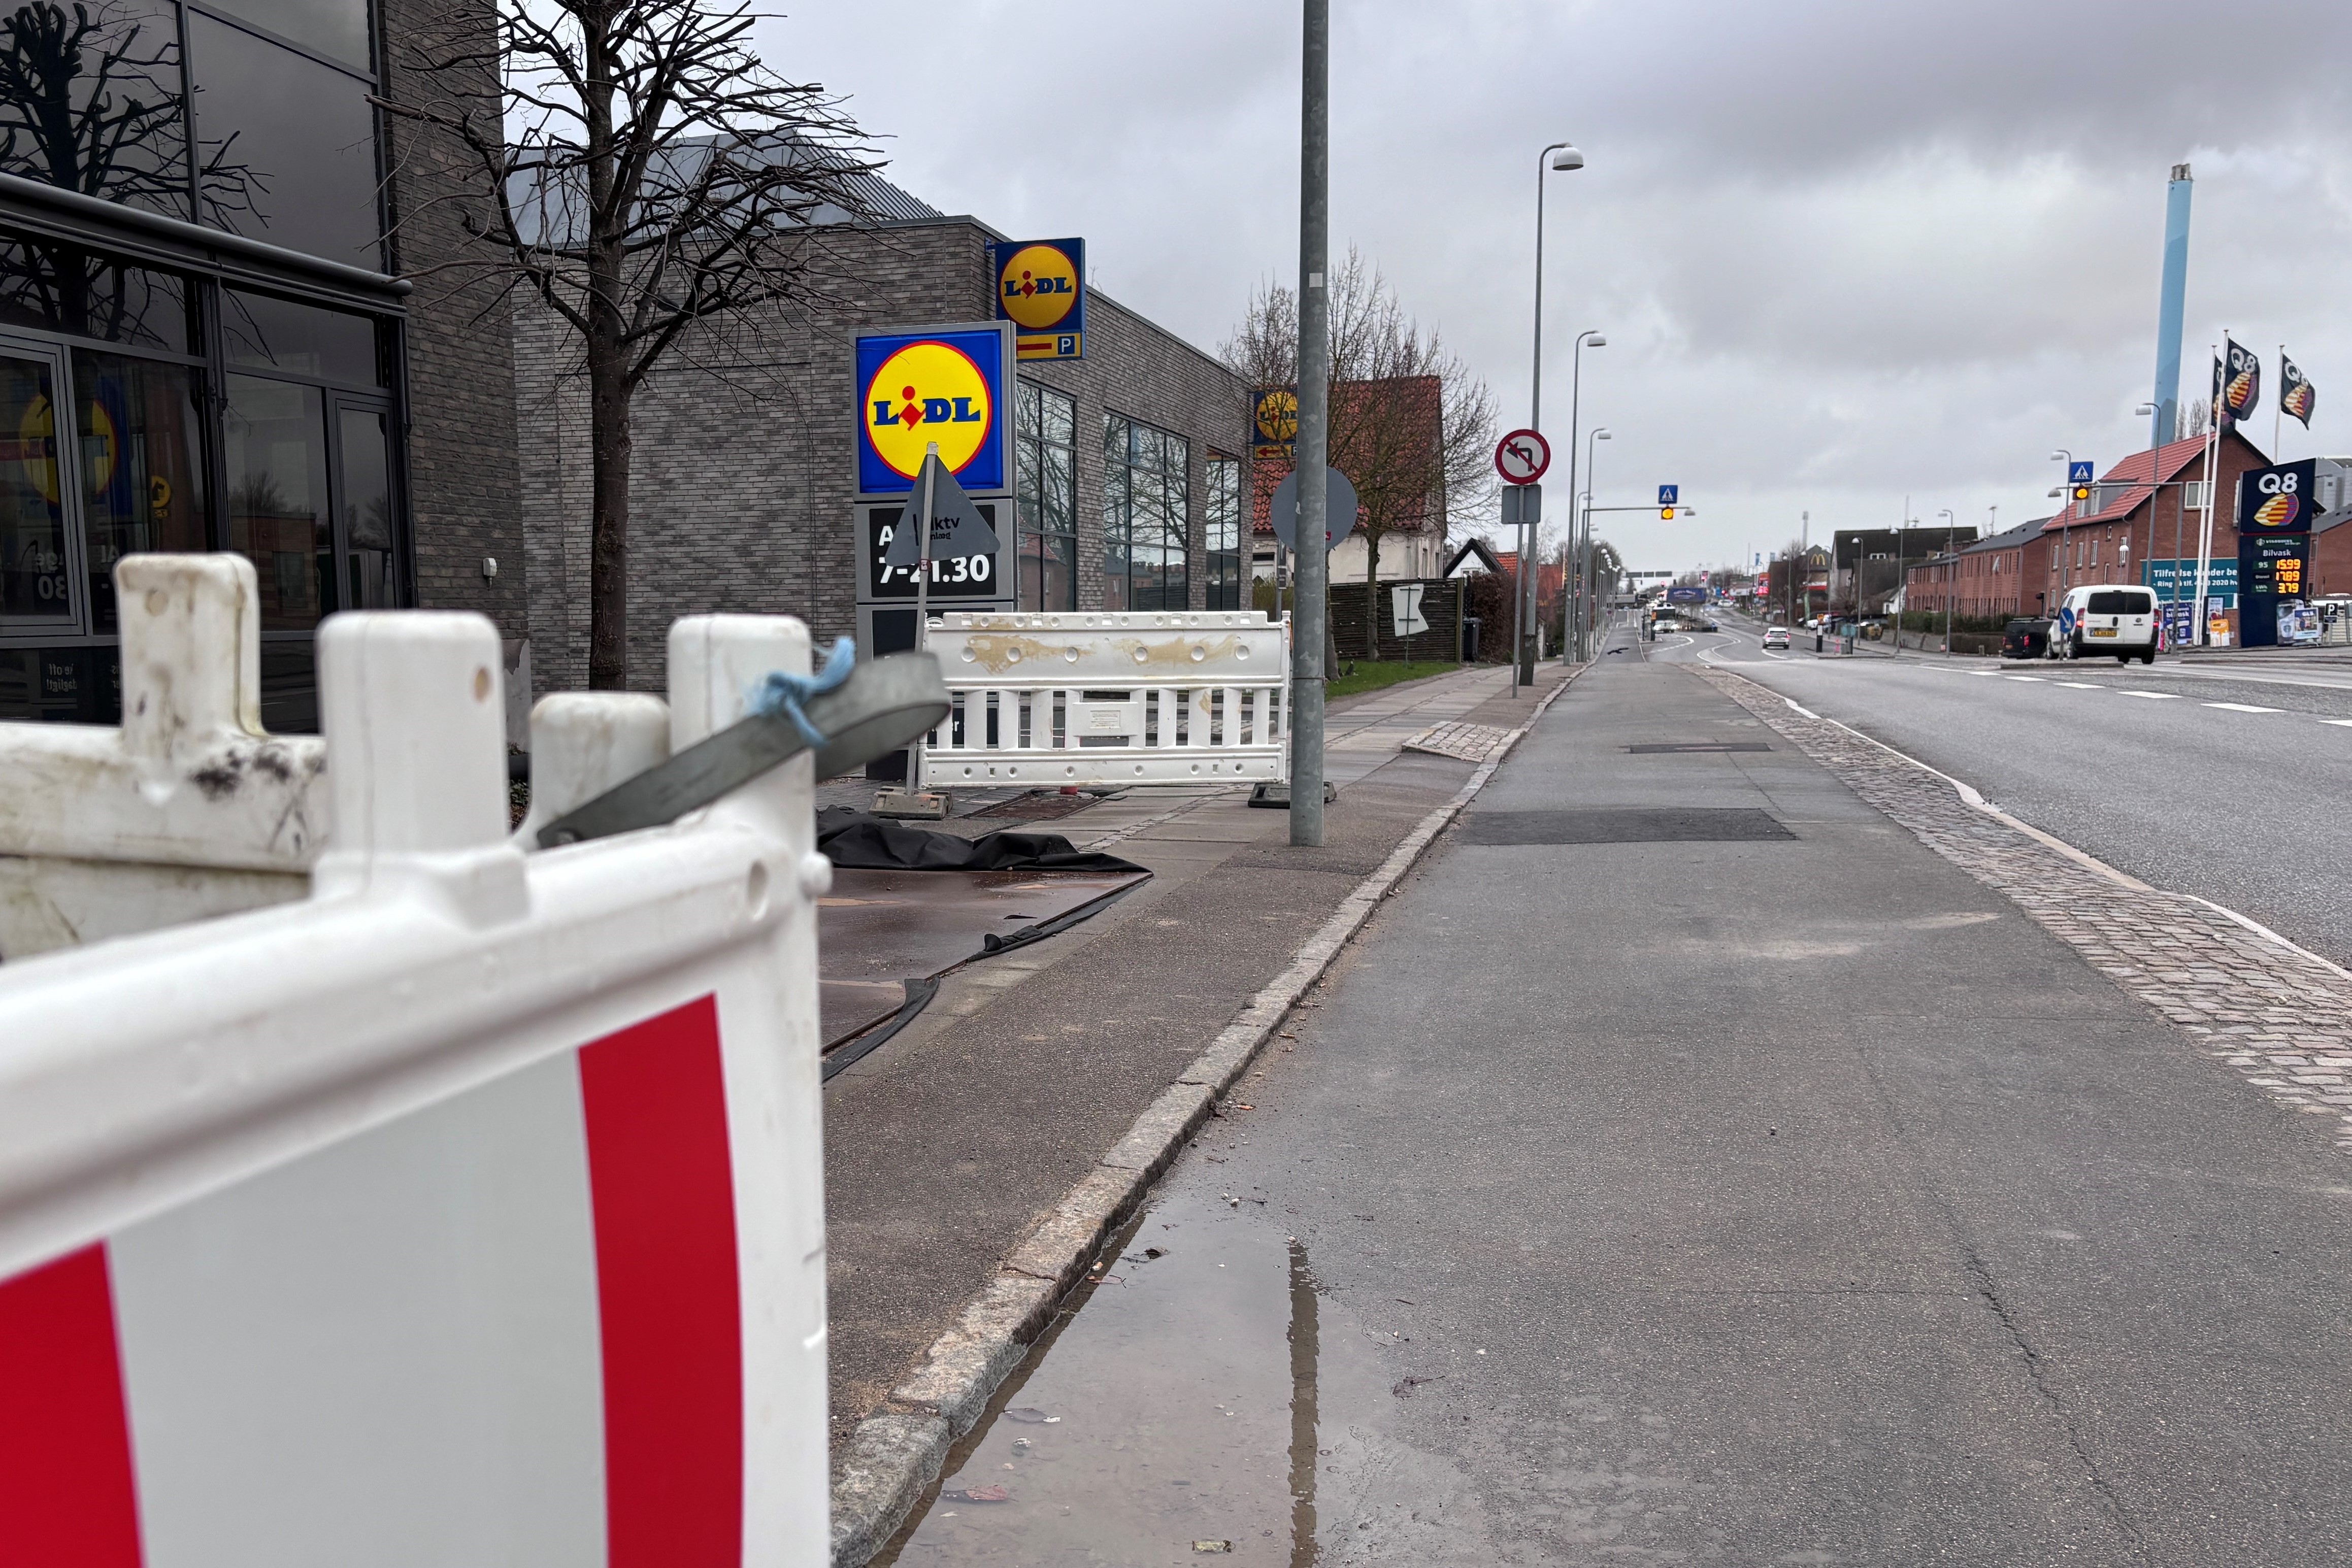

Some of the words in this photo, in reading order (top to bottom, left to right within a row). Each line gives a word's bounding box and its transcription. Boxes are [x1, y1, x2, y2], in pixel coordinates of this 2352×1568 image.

[2231, 348, 2256, 373] Q8
[2259, 473, 2298, 493] Q8
[2328, 604, 2335, 616] P
